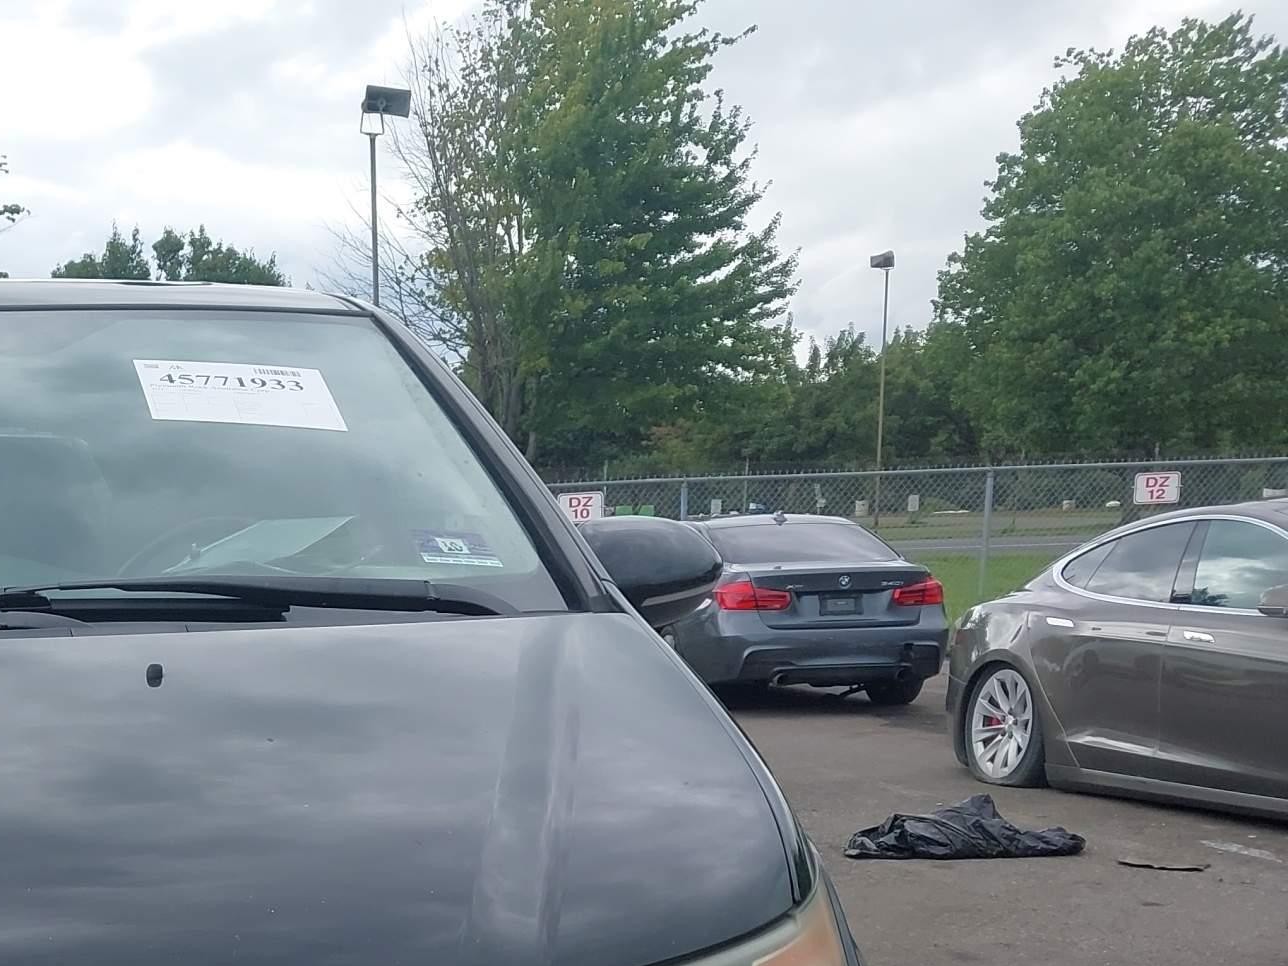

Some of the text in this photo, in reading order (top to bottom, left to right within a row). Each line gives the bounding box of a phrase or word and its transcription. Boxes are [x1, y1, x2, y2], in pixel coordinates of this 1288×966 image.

[159, 373, 304, 392] 45771933
[1145, 476, 1171, 488] DZ
[1148, 488, 1166, 500] 12
[568, 496, 593, 508] DZ
[572, 508, 590, 519] 10
